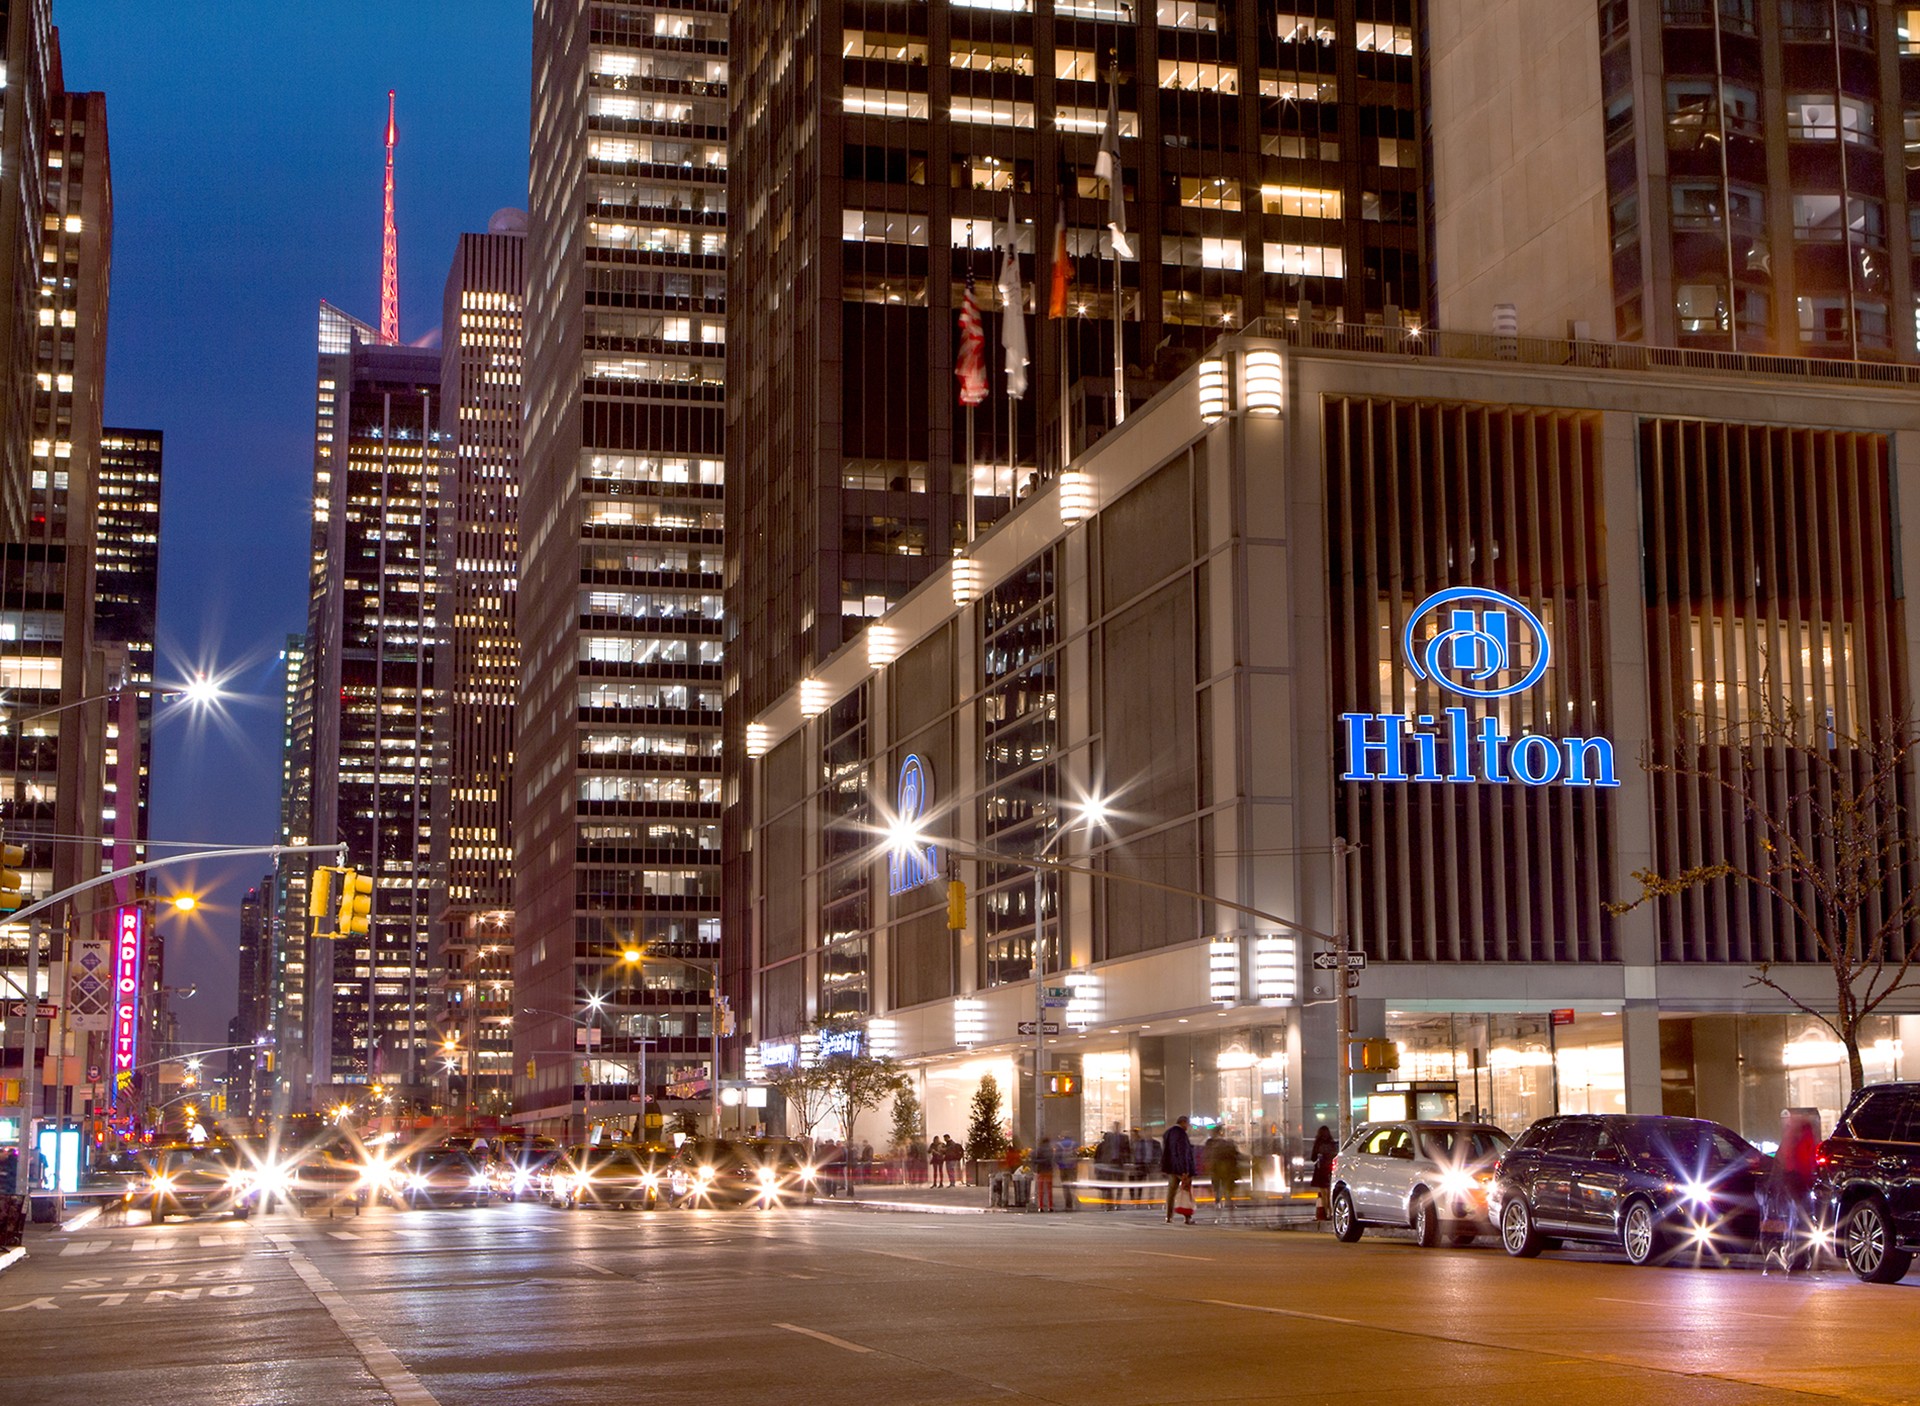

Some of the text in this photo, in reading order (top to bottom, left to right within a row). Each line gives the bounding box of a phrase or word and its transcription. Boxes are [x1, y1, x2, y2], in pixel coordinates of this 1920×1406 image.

[1341, 706, 1622, 788] Hilton
[120, 914, 136, 992] RADIO
[1320, 957, 1336, 965] ONE
[117, 1005, 133, 1067] CITY
[0, 1284, 255, 1312] ONLY
